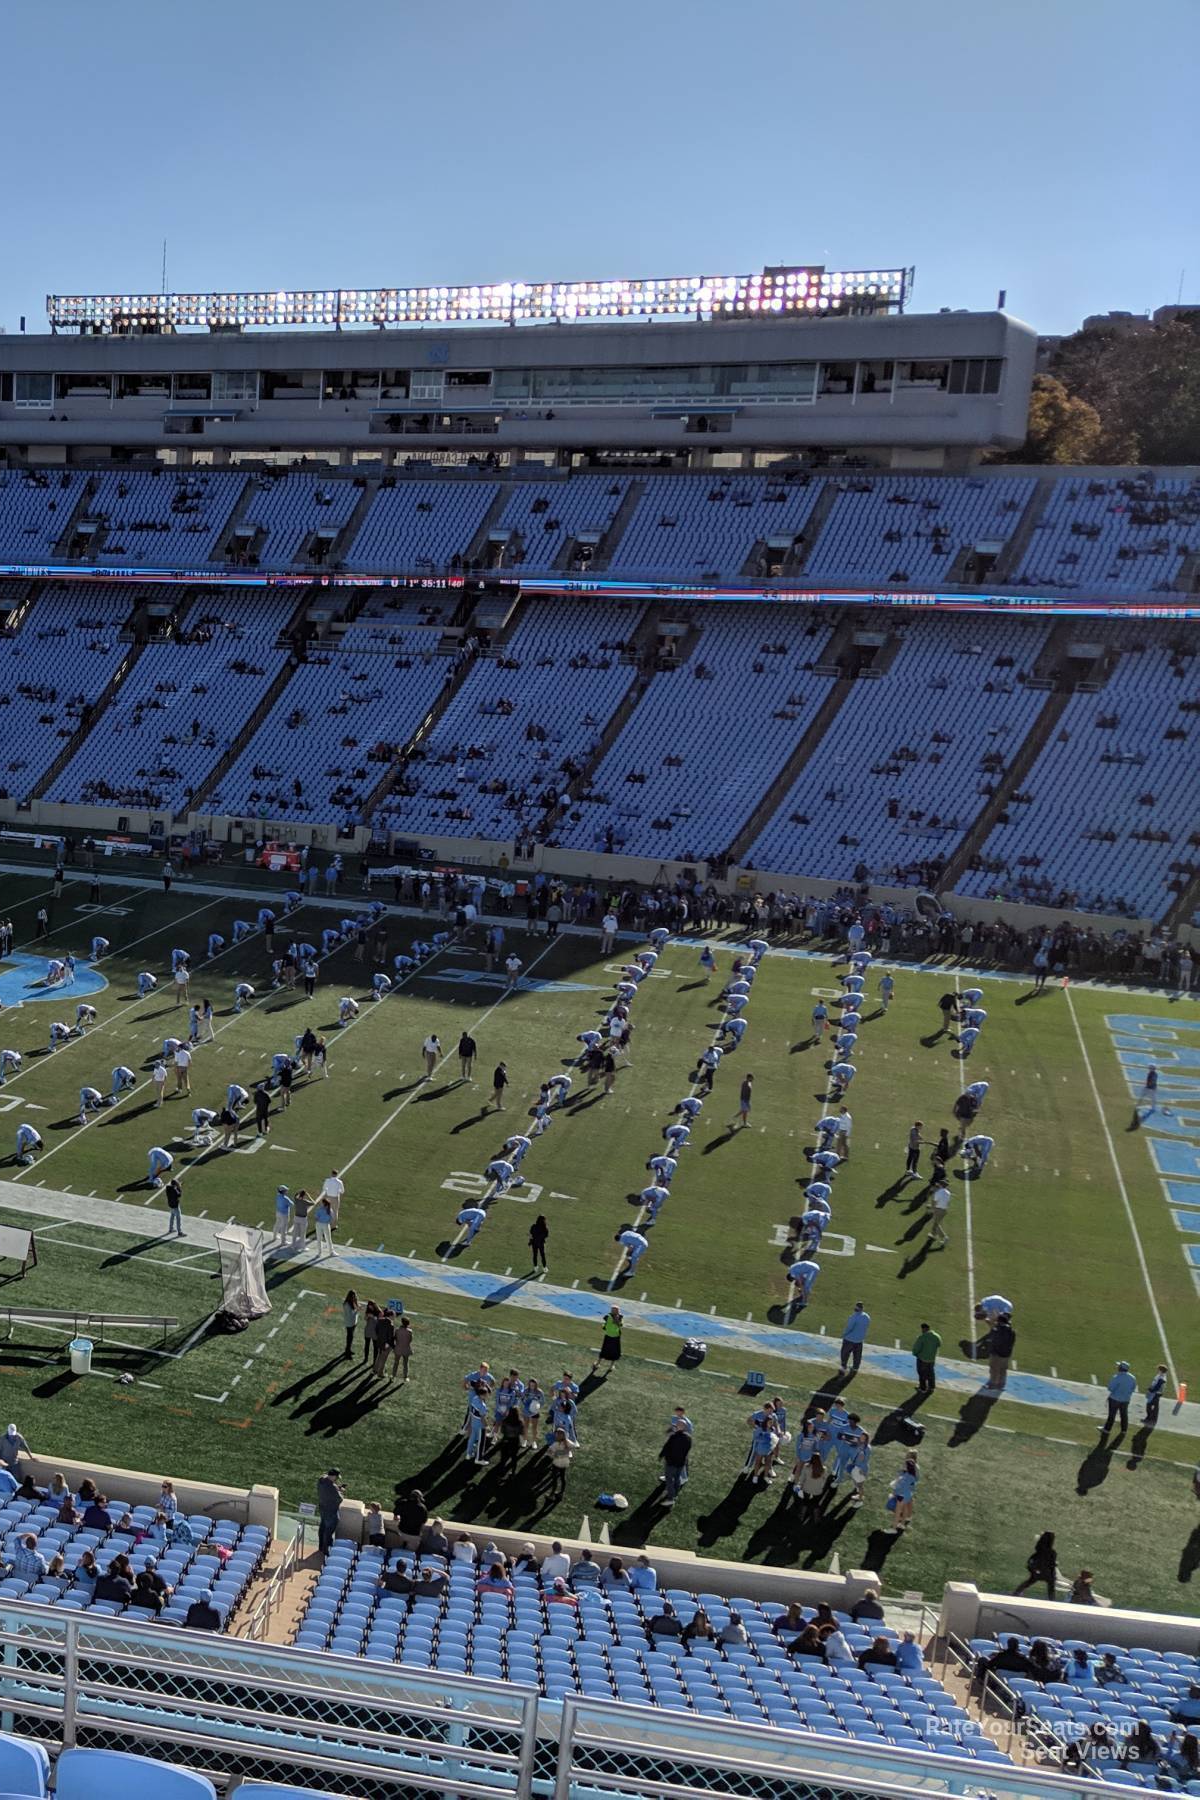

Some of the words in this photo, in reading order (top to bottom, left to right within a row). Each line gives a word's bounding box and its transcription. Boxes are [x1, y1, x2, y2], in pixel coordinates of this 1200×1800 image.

[421, 579, 447, 588] 35:11
[451, 580, 462, 588] 40
[440, 1171, 543, 1203] 20
[748, 1371, 763, 1385] 10
